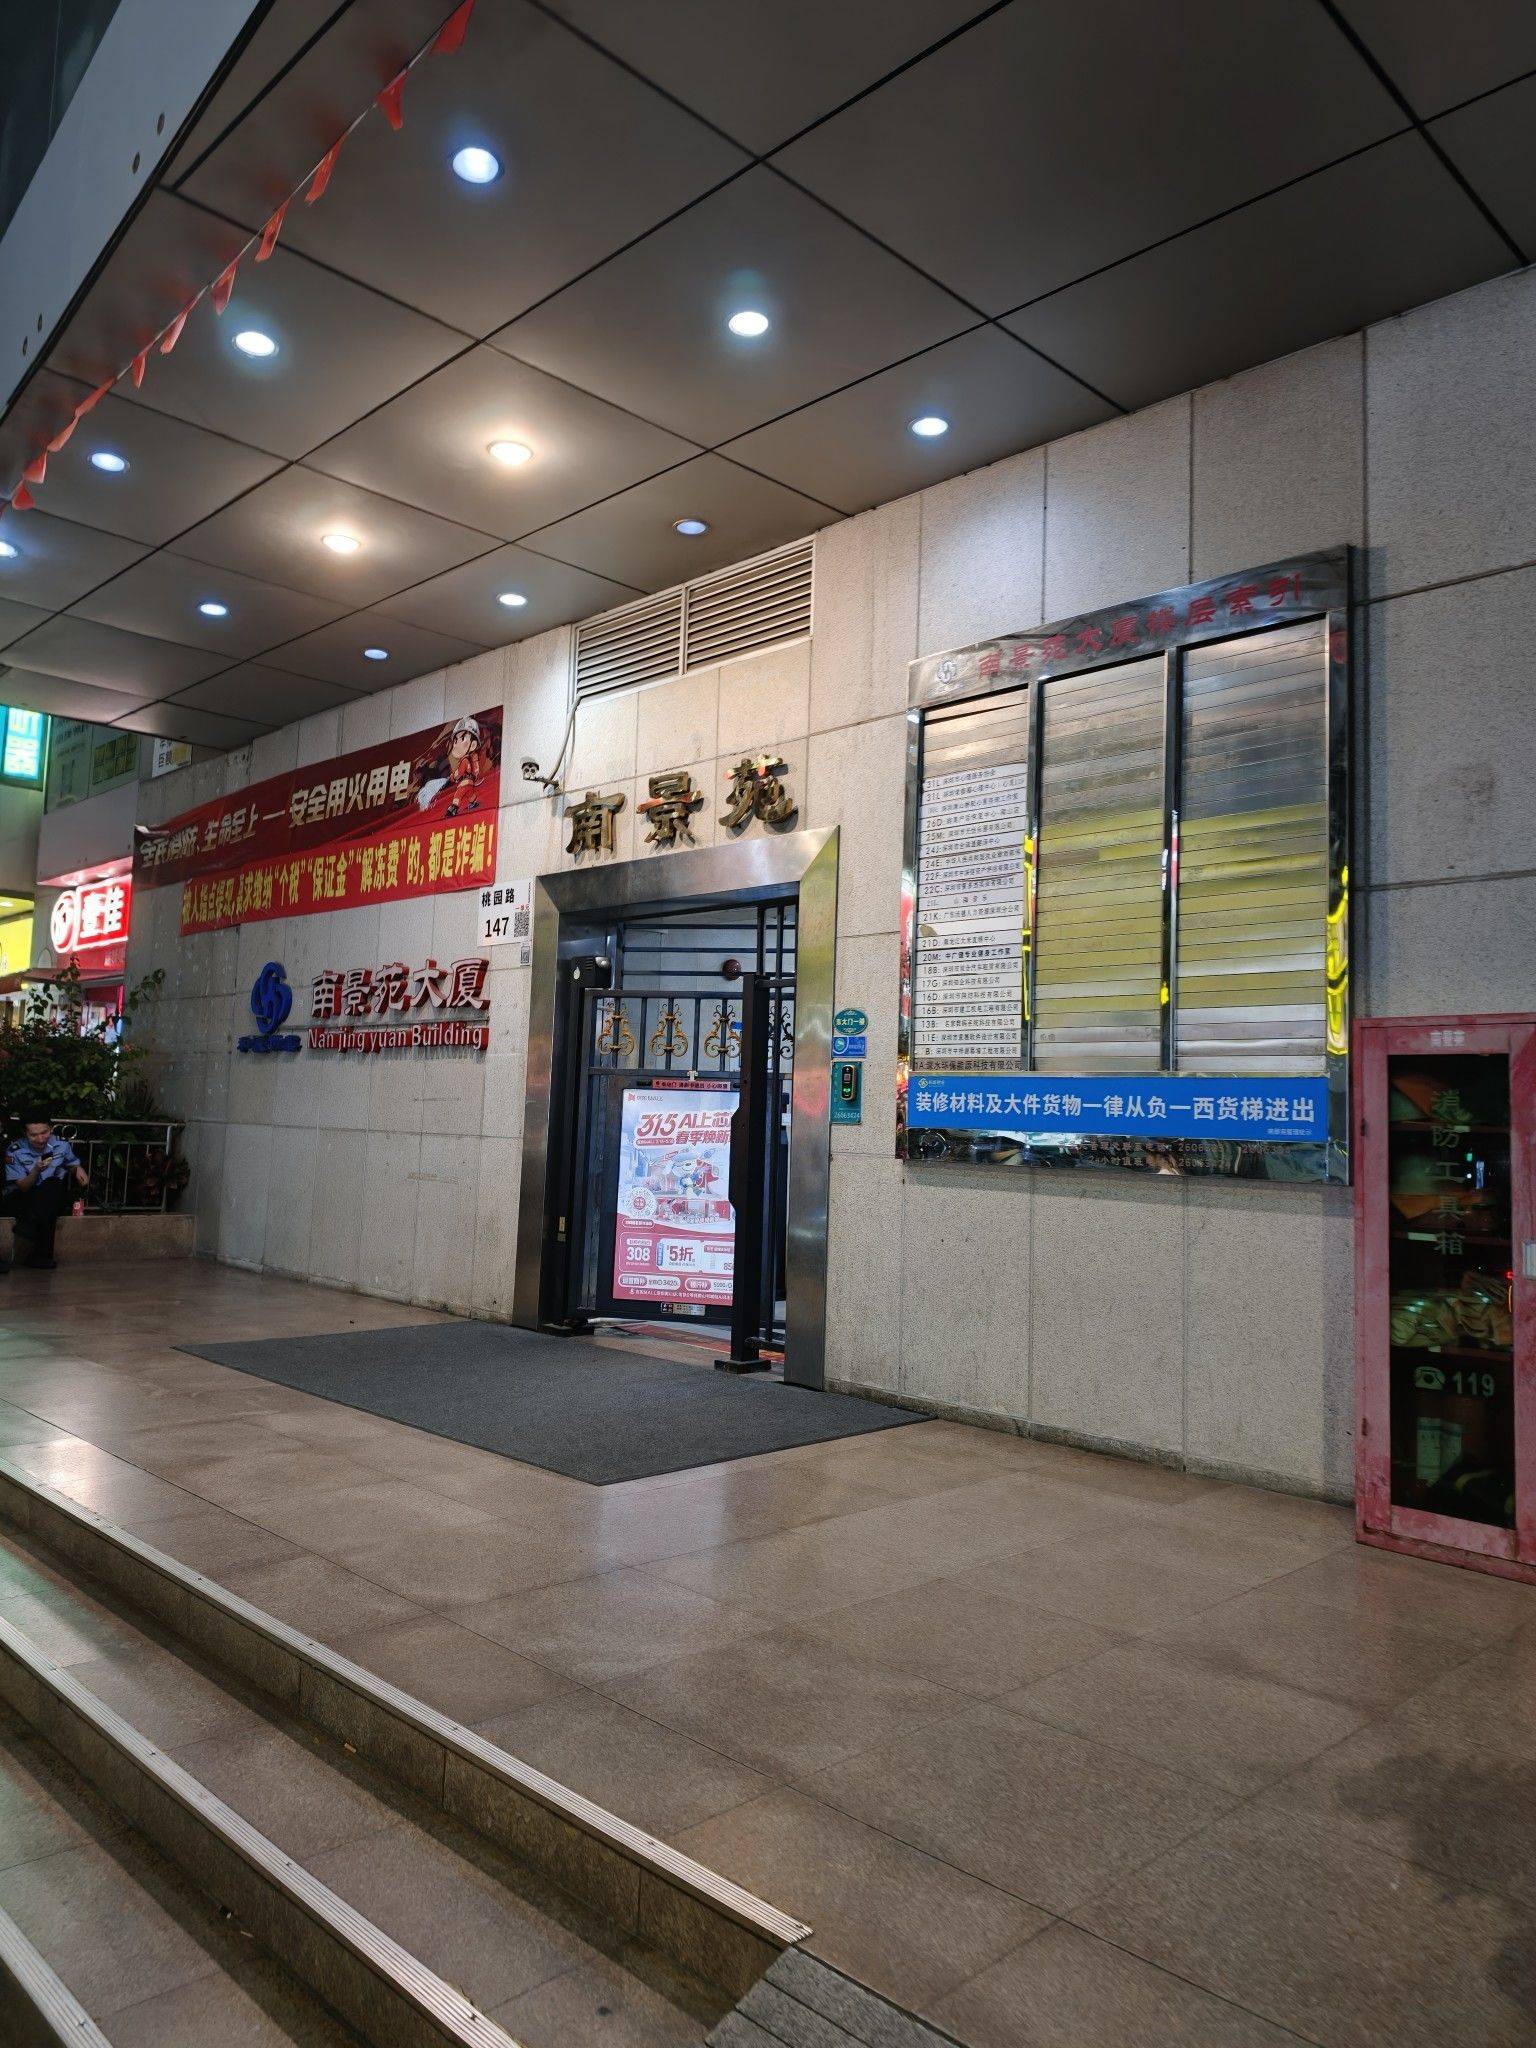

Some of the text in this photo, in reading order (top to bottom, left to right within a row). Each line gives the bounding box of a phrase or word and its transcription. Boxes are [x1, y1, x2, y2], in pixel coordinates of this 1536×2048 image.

[564, 754, 794, 854] 南景苑
[482, 888, 515, 908] 桃园路
[485, 917, 509, 938] 147
[312, 959, 490, 1018] 南景苑大厦
[307, 1027, 335, 1049] Nan
[337, 1027, 365, 1051] jing
[370, 1030, 407, 1051] yuan
[411, 1021, 484, 1050] Building
[916, 1092, 1315, 1123] 装修材料及大件货物一律从负一西货梯进出
[637, 1113, 678, 1137] 315
[1452, 1371, 1495, 1397] 119
